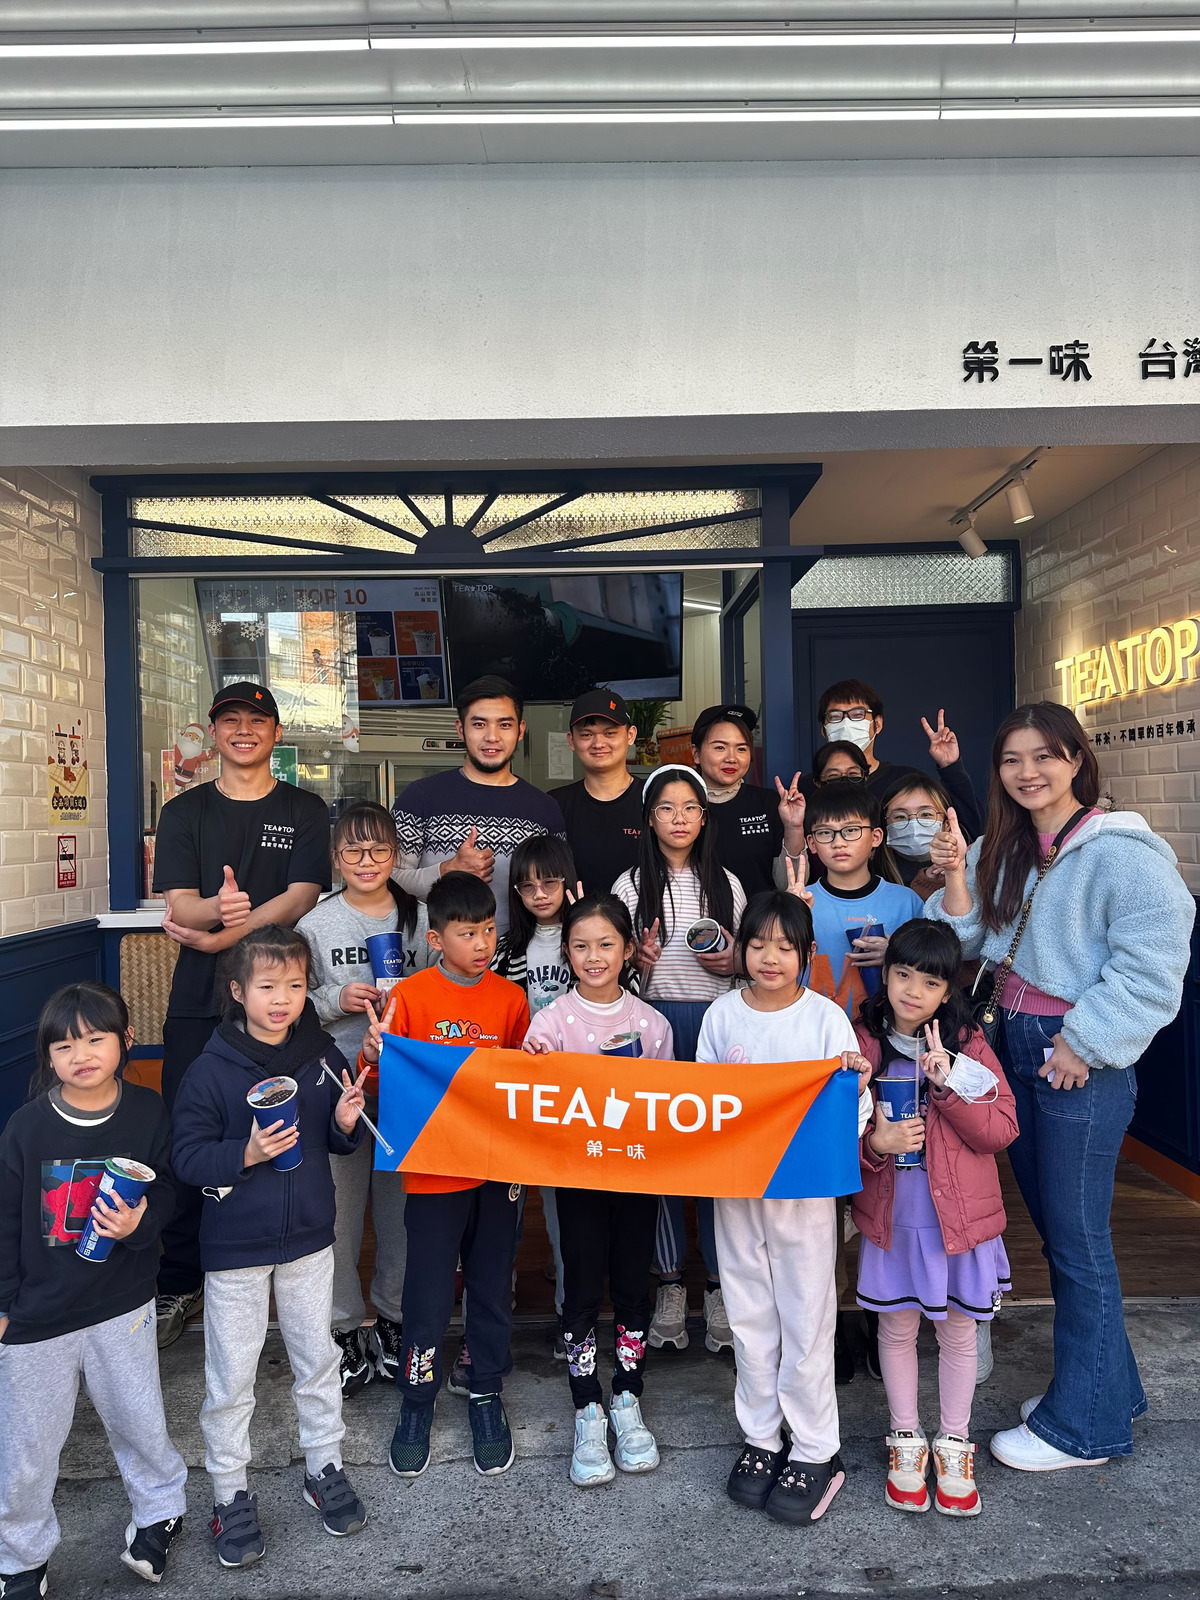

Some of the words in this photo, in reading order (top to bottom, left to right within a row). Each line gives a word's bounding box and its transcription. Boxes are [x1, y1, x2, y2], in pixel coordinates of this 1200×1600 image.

[963, 340, 1093, 383] 第一味
[294, 589, 337, 605] TOP
[344, 588, 368, 605] 10
[475, 584, 494, 592] TOP
[1054, 618, 1199, 706] TEATOP
[331, 947, 371, 966] RED
[435, 1019, 482, 1039] TAYO
[494, 1081, 597, 1128] TEA
[634, 1091, 743, 1133] TOP
[586, 1140, 646, 1160] 第一味
